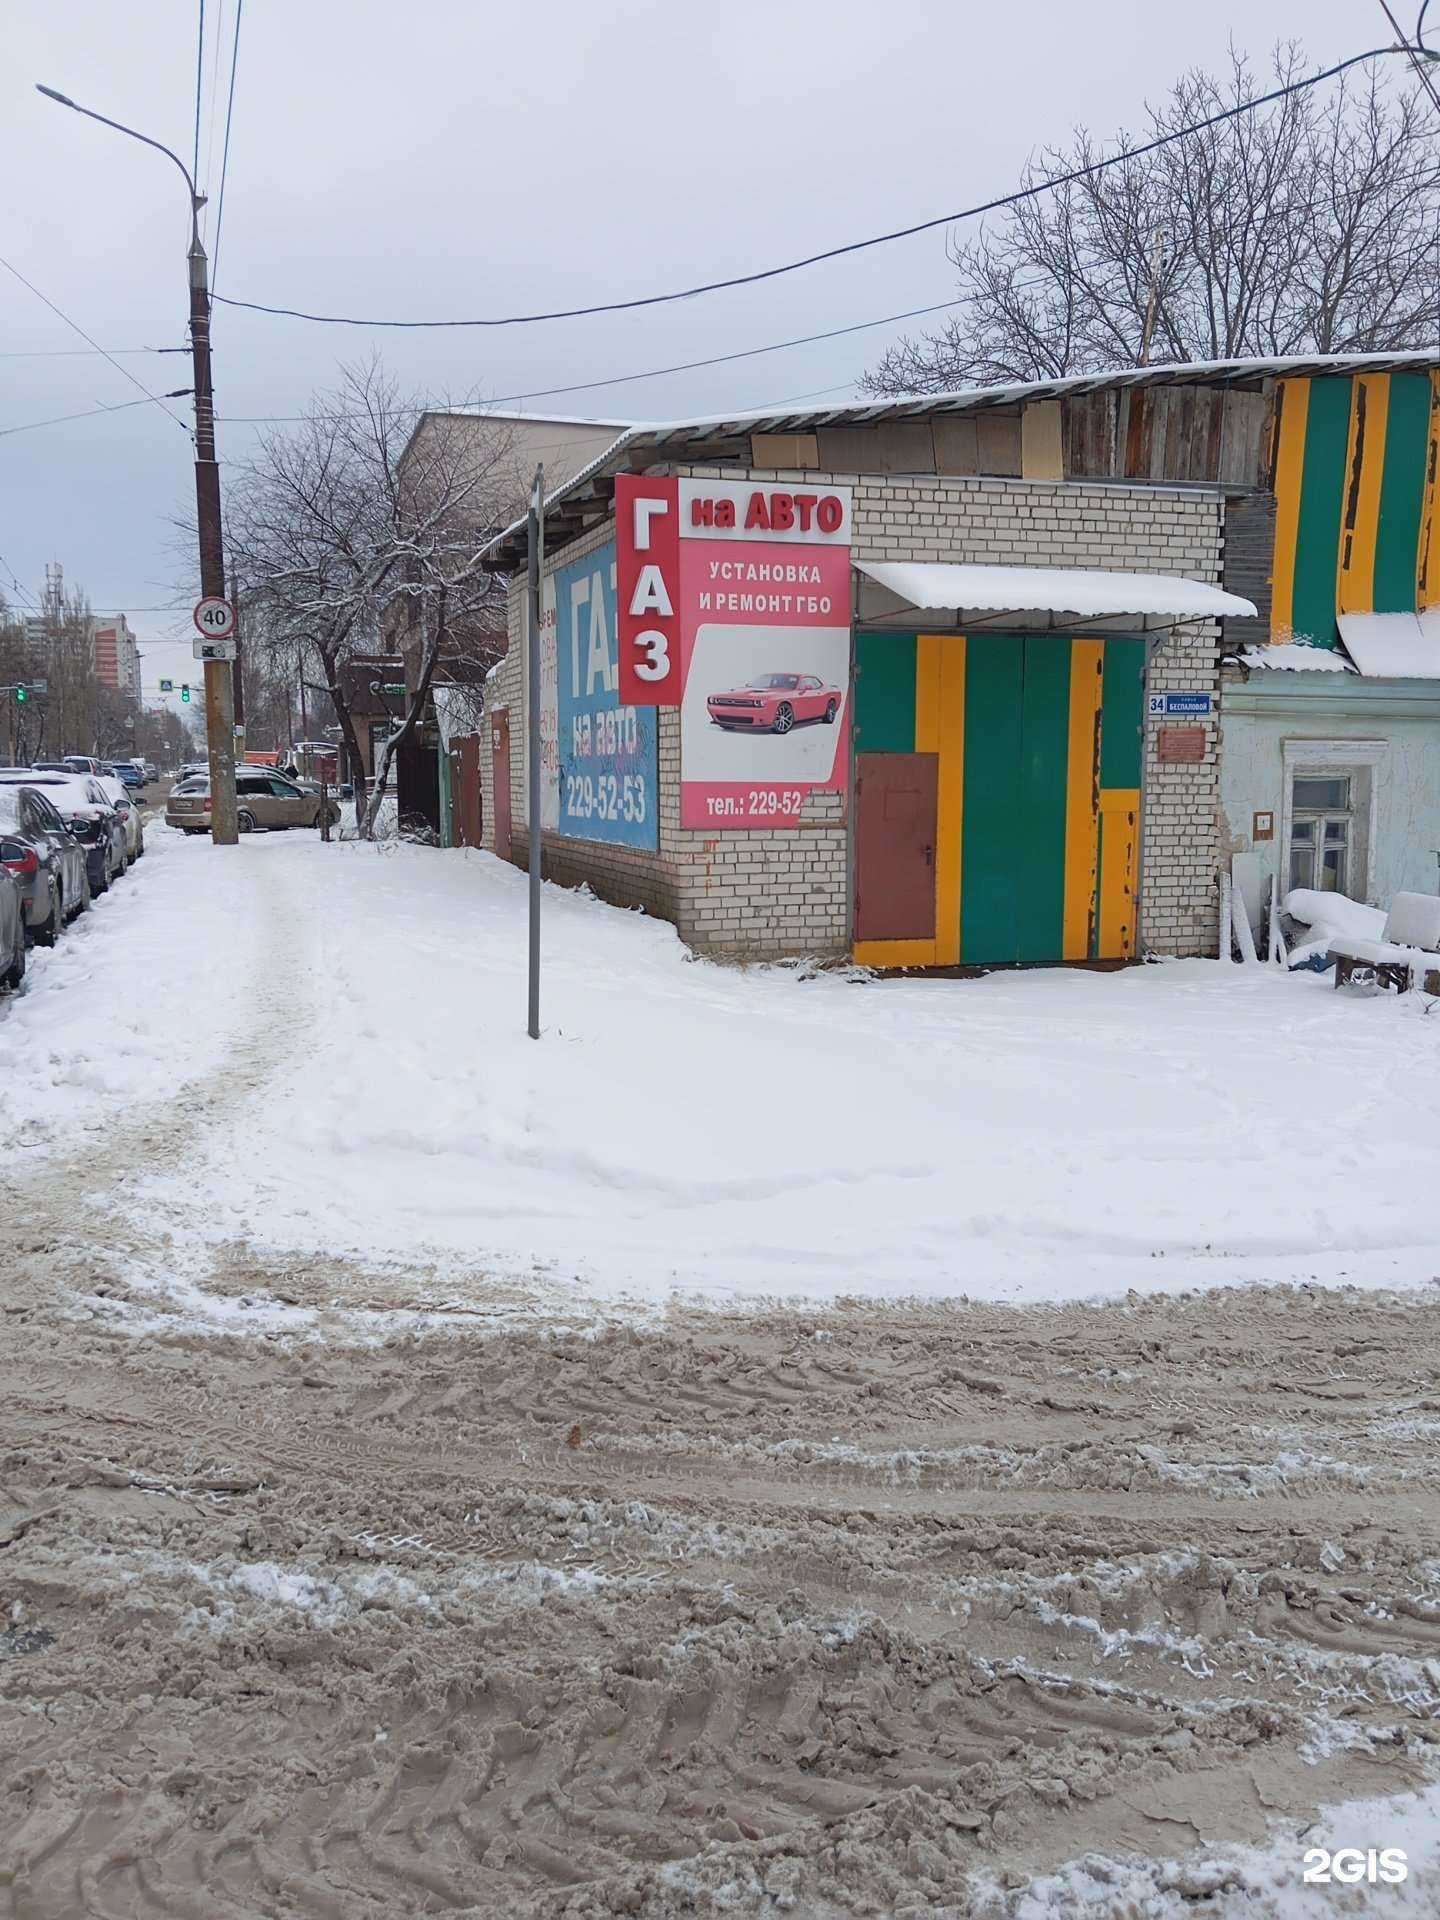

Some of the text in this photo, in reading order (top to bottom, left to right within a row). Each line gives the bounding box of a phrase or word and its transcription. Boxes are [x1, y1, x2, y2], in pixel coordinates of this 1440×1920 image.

[691, 491, 843, 533] на АВТО
[709, 560, 821, 584] УСТАНОВКА
[628, 497, 674, 684] ГАЗ
[699, 593, 832, 614] И РЕМОНТ ГБО
[204, 610, 226, 625] 40
[570, 562, 618, 698] ГА
[1150, 698, 1164, 711] 34
[573, 713, 591, 757] на
[596, 706, 638, 754] авто
[566, 774, 646, 824] 229-52-53
[707, 797, 744, 816] тел.:
